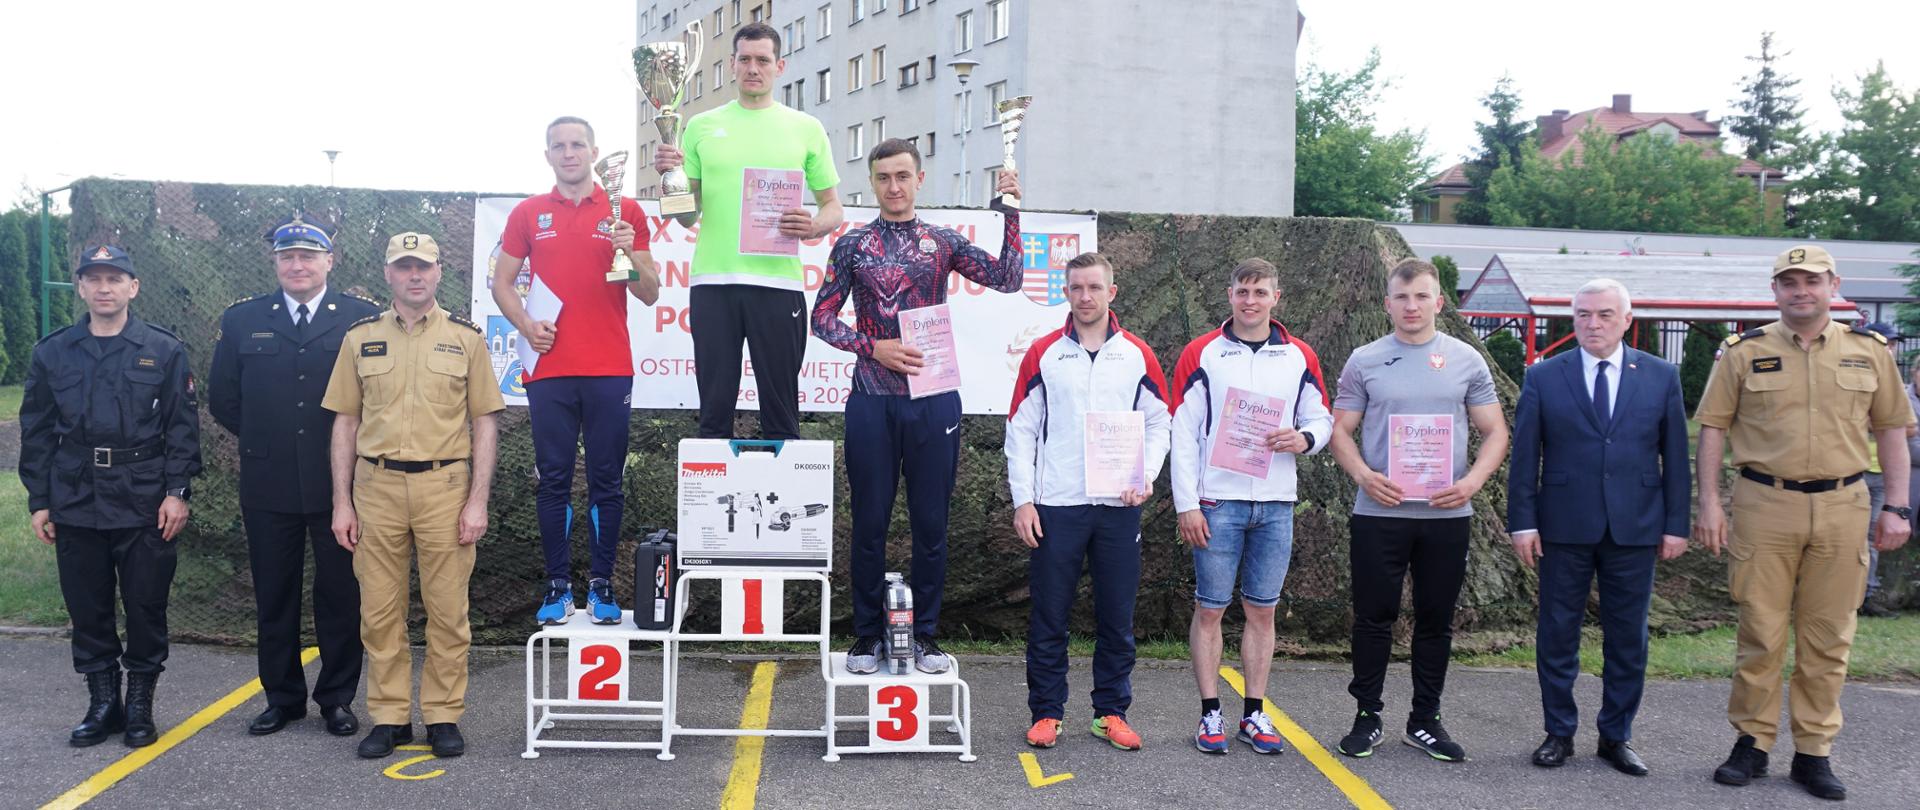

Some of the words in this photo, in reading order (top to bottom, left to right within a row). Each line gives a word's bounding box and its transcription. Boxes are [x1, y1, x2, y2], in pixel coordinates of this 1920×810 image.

[757, 179, 800, 192] Dyplom
[913, 317, 949, 331] Dyplom
[1238, 399, 1280, 418] Dyplom
[1099, 422, 1141, 434] Dyplom
[1405, 425, 1449, 438] Dyplom
[682, 466, 726, 479] makita
[742, 578, 764, 635] 1
[578, 644, 622, 701] 2
[876, 685, 918, 742] 3
